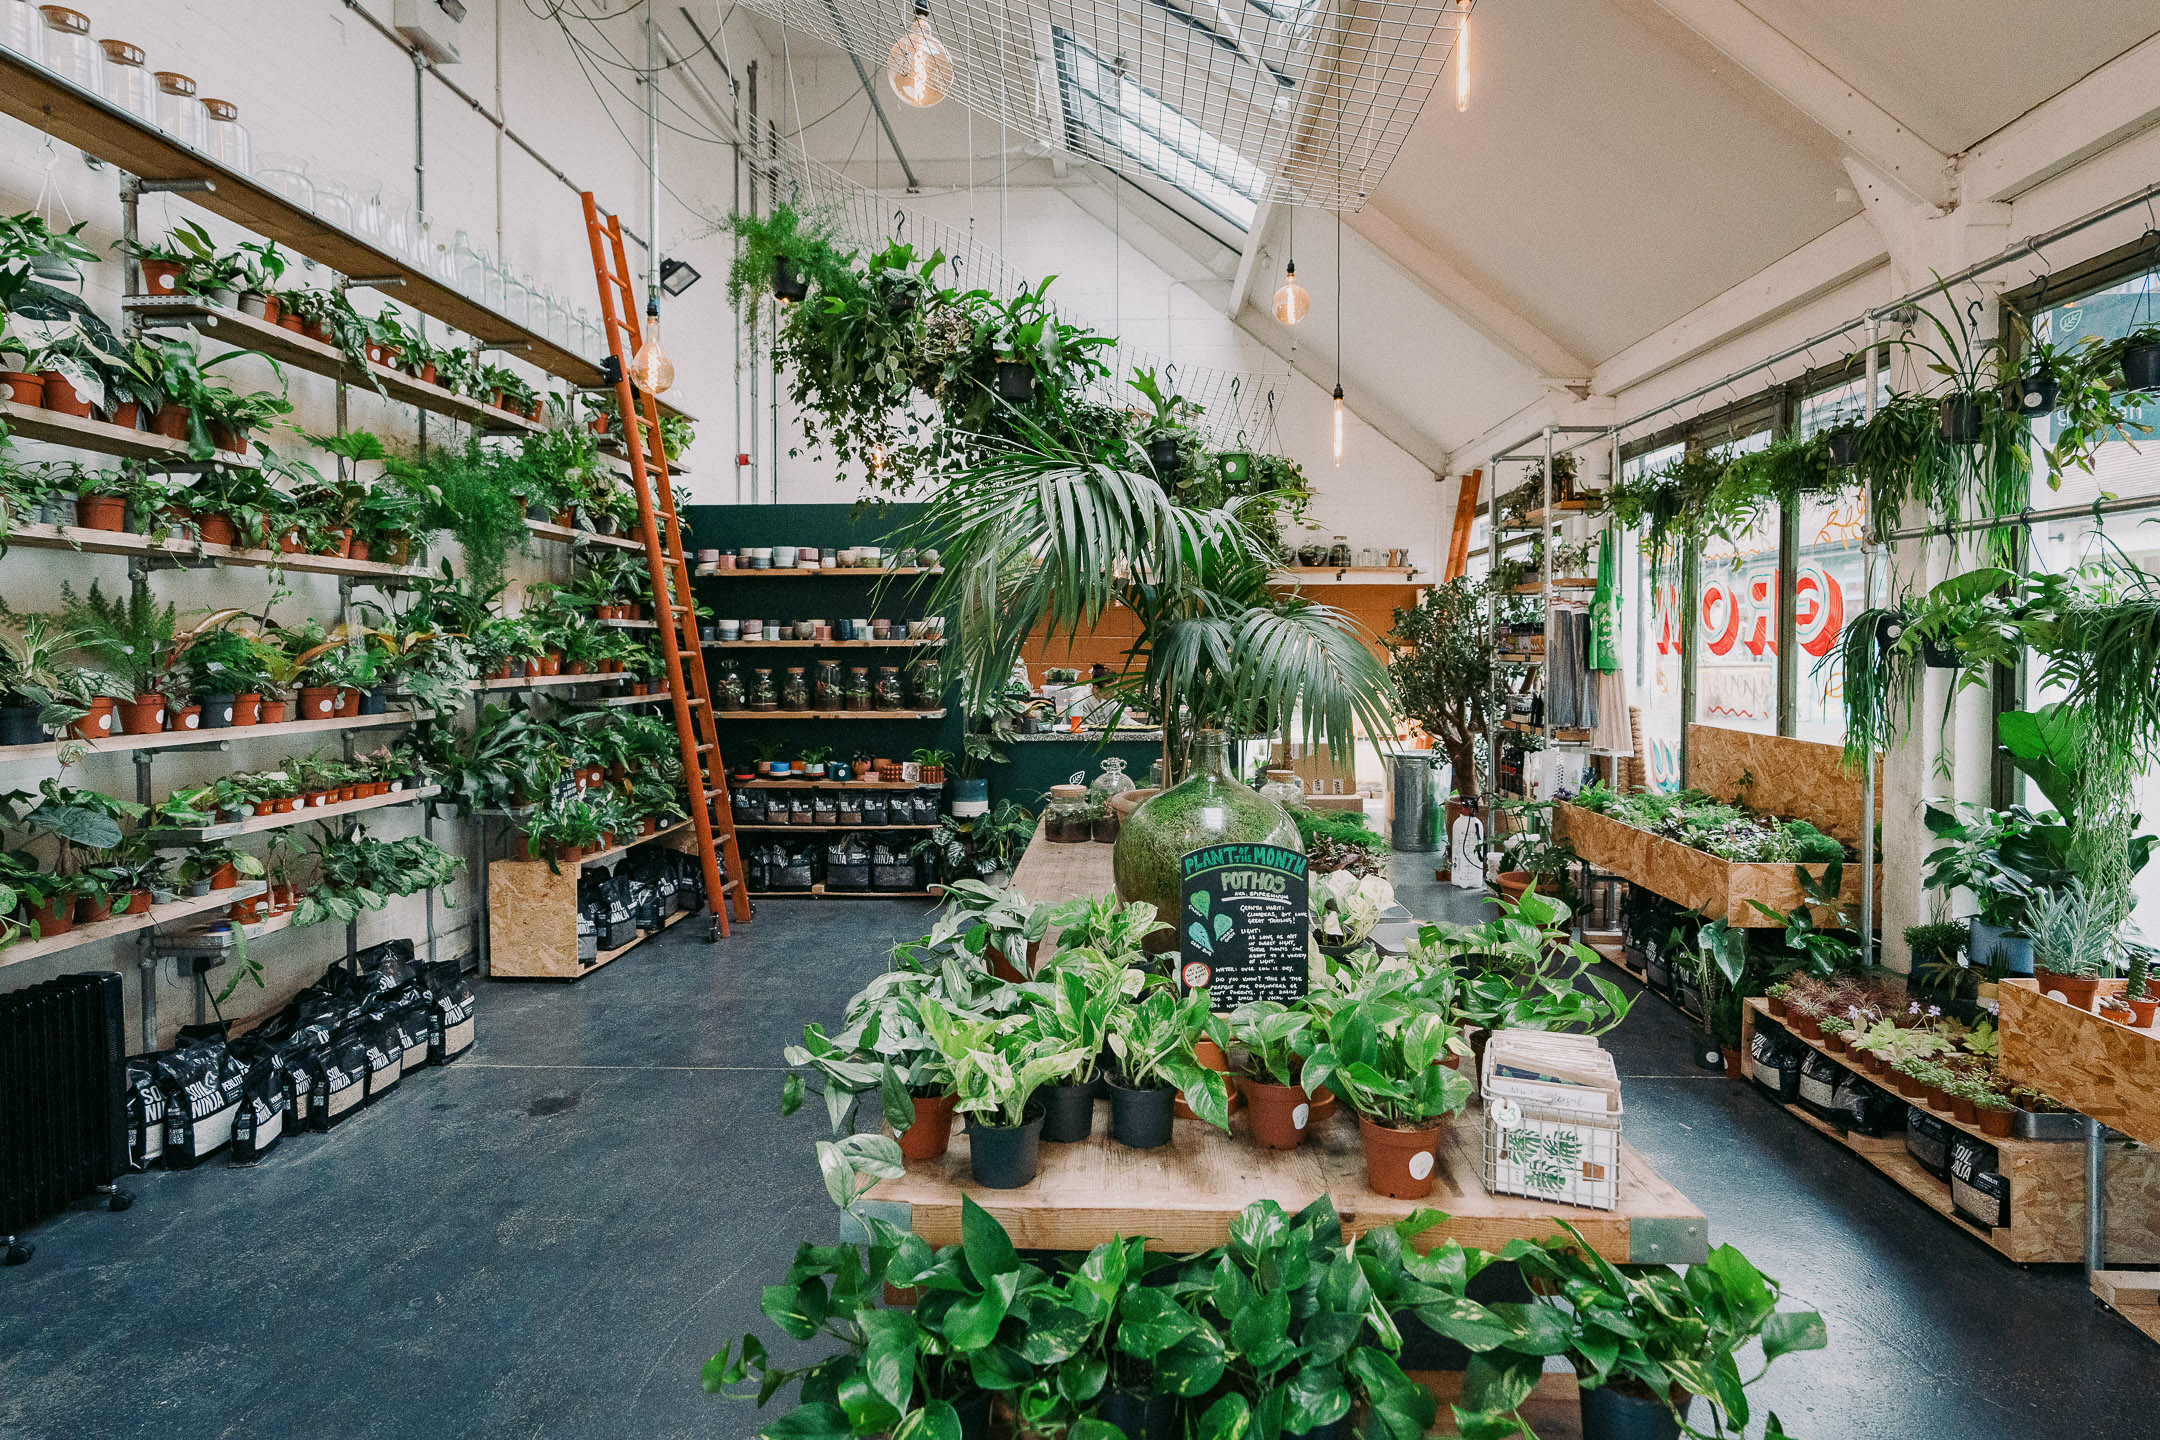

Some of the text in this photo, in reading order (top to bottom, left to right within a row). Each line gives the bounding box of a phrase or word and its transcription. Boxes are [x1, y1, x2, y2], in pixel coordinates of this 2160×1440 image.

[874, 845, 892, 854] SOIL
[873, 854, 895, 865] NINJA
[1185, 847, 1237, 875] PLANT
[1254, 847, 1307, 875] MONTH
[1221, 871, 1285, 894] POTHOS
[610, 900, 625, 912] OIL
[366, 1046, 384, 1061] SOIL
[327, 1066, 345, 1081] SOIL
[185, 1081, 216, 1101] SOIL
[330, 1074, 351, 1093] NINJA
[191, 1090, 224, 1119] NINJA
[1955, 1145, 1973, 1166] OIL
